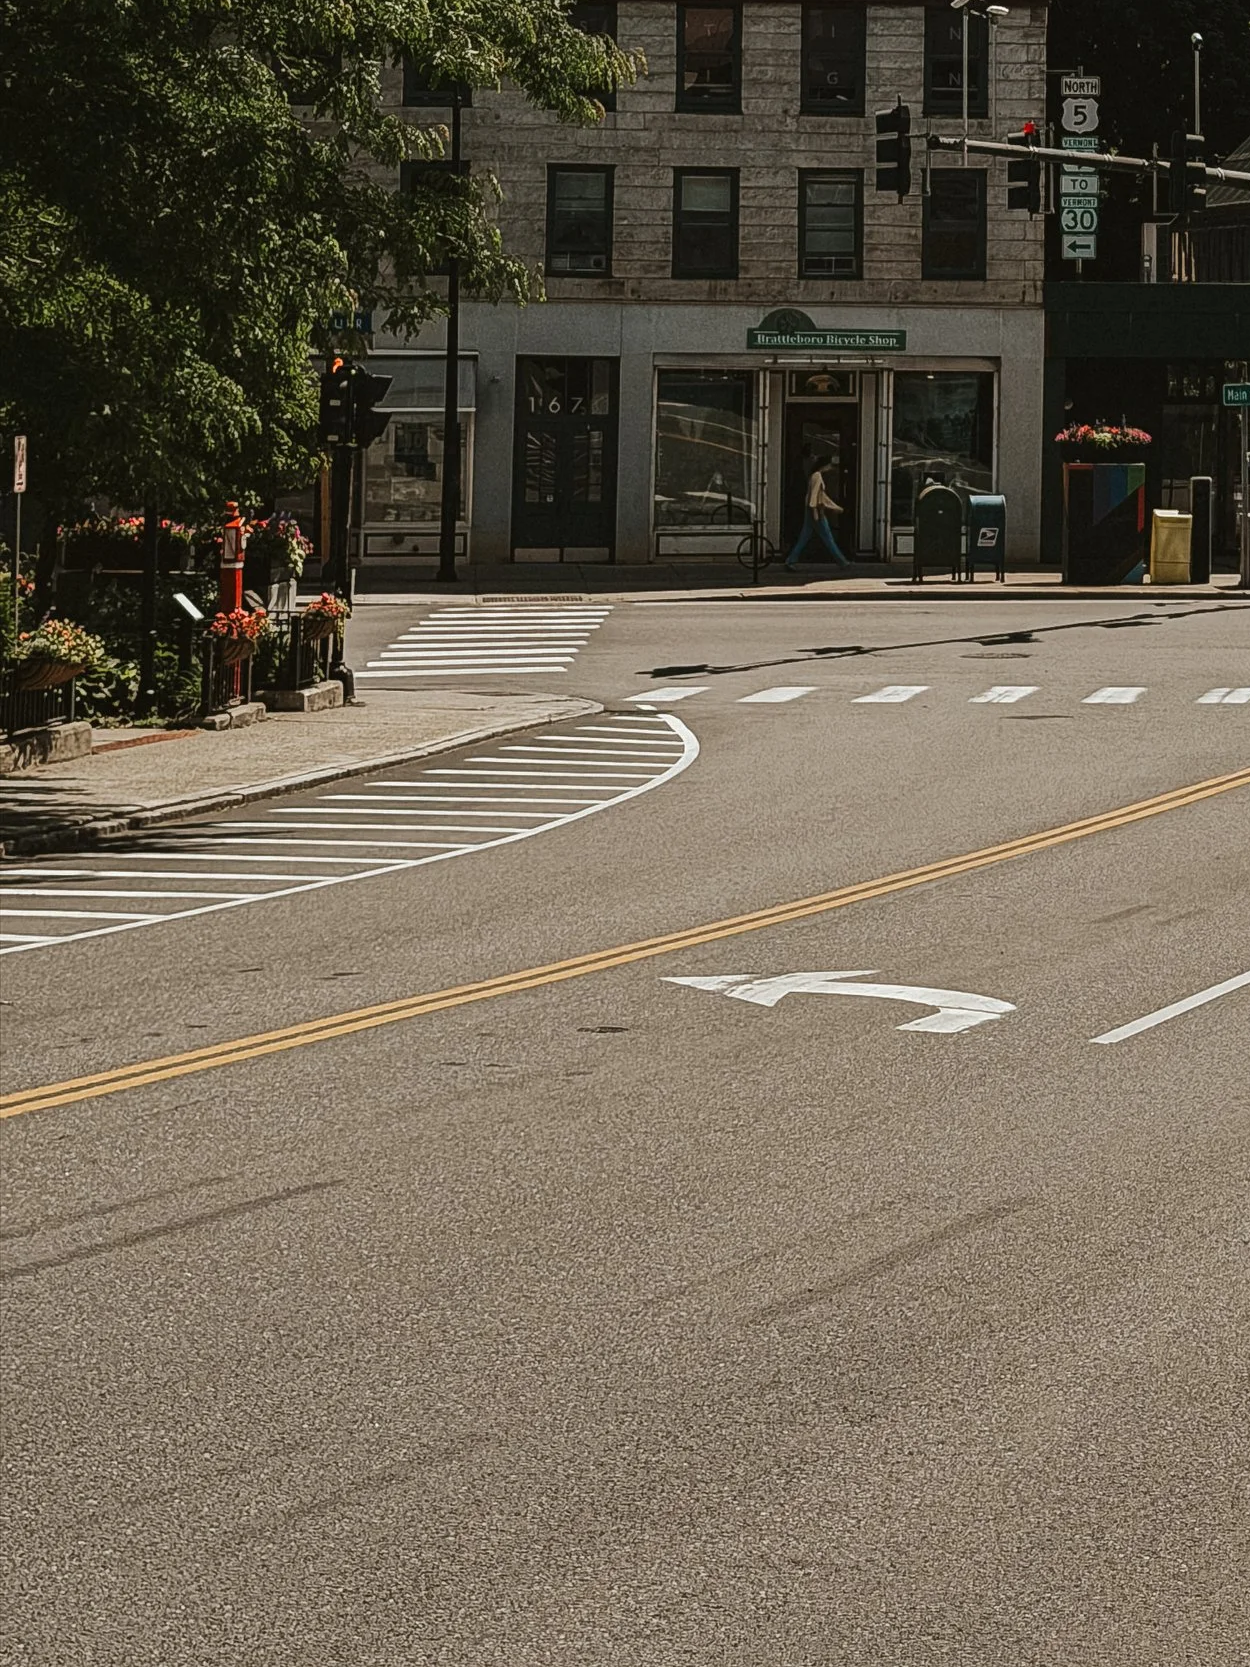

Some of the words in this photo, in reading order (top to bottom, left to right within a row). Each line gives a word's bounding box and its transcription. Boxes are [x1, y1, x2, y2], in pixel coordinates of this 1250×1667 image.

[1064, 80, 1097, 94] NORTH
[1073, 105, 1087, 126] 5
[1063, 139, 1098, 147] VERMONT
[1071, 179, 1089, 190] TO
[1063, 198, 1096, 206] VERMONT
[1065, 210, 1094, 230] 30
[757, 334, 824, 344] Brattleboro
[826, 335, 866, 345] Bicycle
[869, 335, 897, 346] Shop
[1227, 389, 1247, 401] Main
